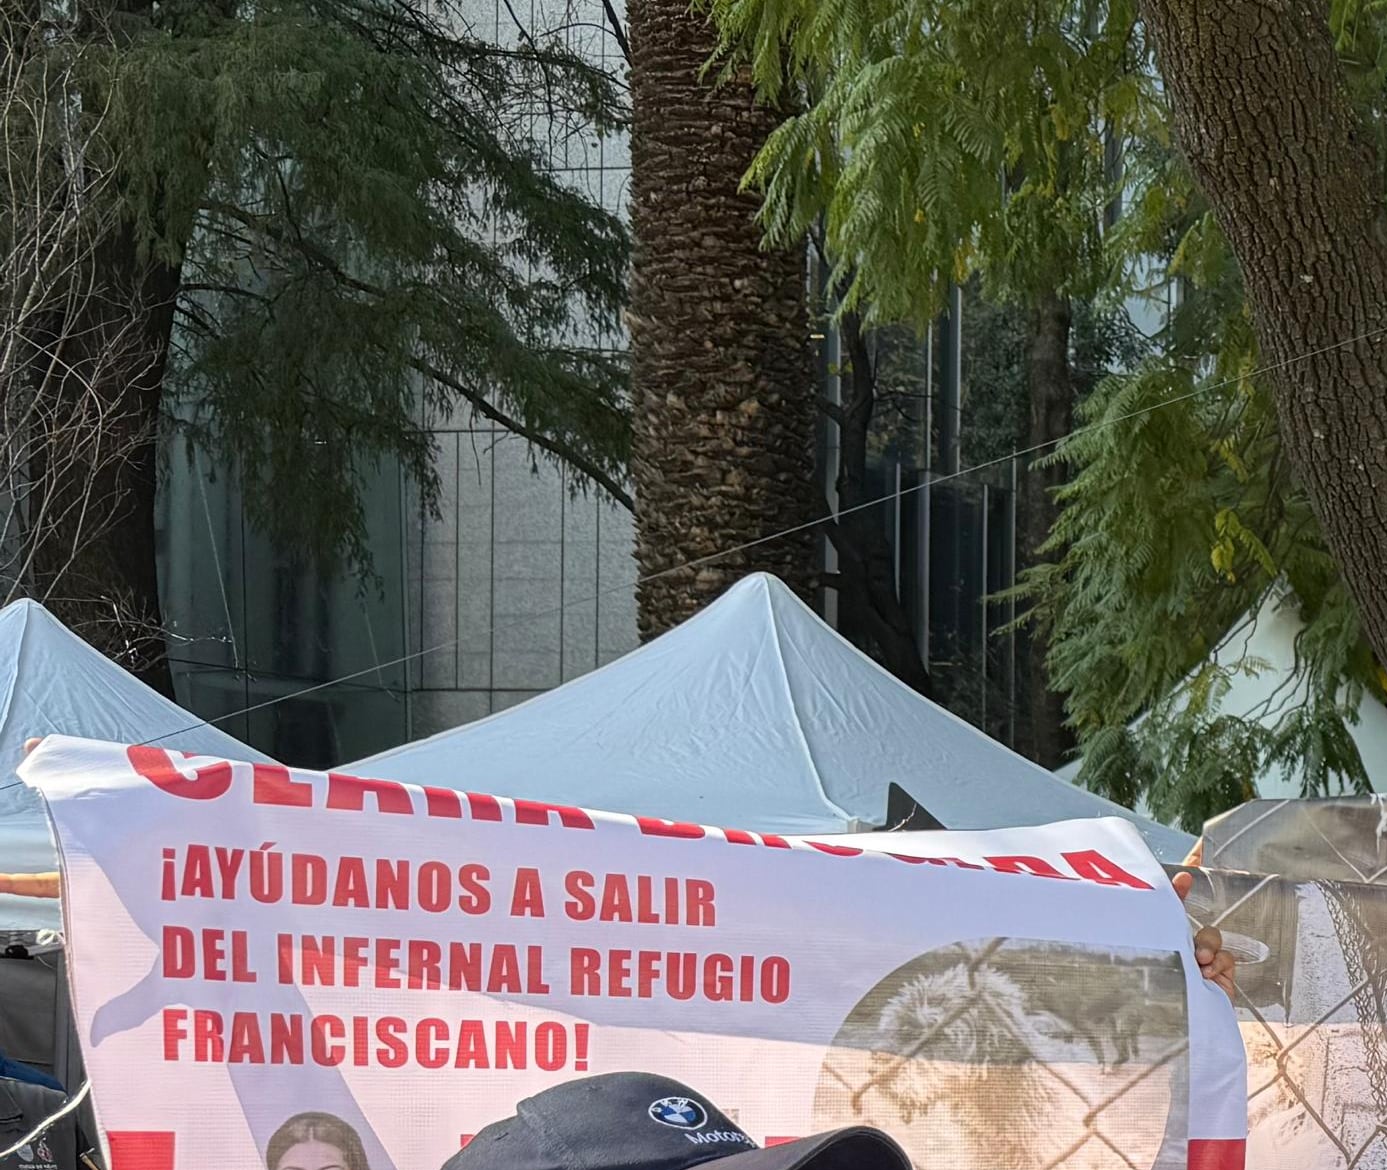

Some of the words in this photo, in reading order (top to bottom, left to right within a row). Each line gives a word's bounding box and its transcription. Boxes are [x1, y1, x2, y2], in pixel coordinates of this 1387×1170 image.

[161, 841, 491, 916] ¡AYÚDANOS
[510, 867, 545, 919] A
[564, 869, 717, 927] SALIR
[162, 925, 257, 984] DEL
[277, 932, 550, 995] INFERNAL
[570, 946, 791, 1005] REFUGIO
[162, 1008, 589, 1072] FRANCISCANO!
